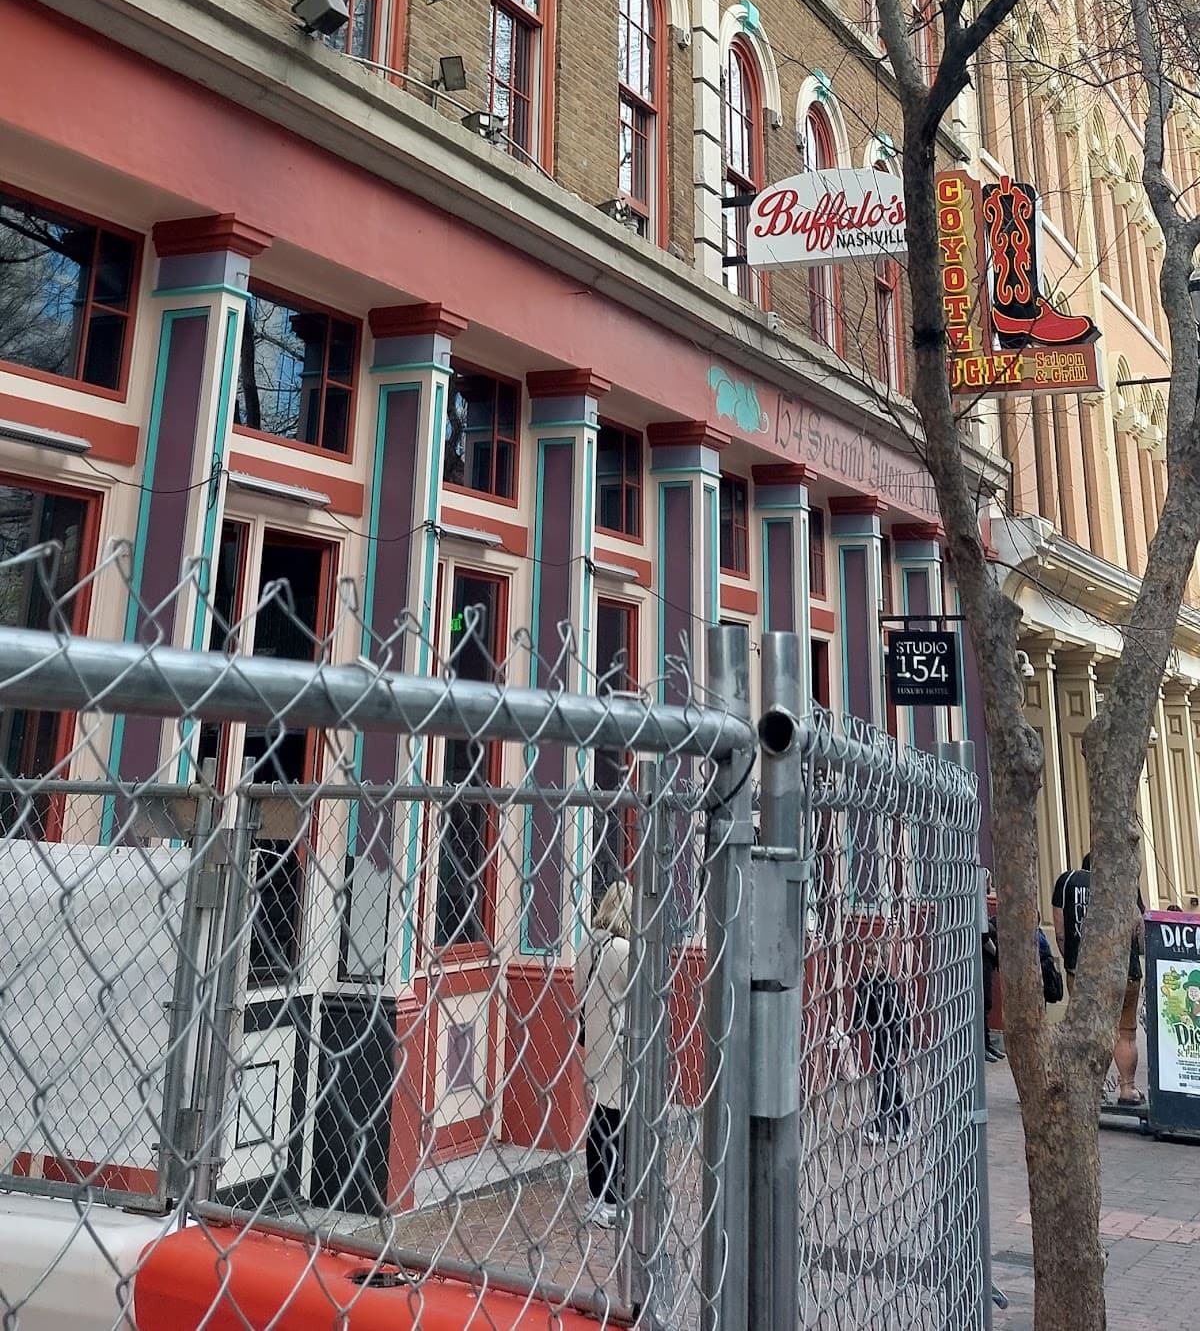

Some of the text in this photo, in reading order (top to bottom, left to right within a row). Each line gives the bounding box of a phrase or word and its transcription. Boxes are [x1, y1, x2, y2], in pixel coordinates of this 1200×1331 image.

[754, 189, 907, 252] Buffalo's
[937, 178, 974, 353] COYOTE
[946, 355, 1023, 387] UGLY
[1034, 351, 1085, 367] Saloon
[1034, 367, 1089, 384] & Grill
[774, 393, 804, 455] 154
[807, 413, 865, 482] Second
[896, 641, 948, 654] STUDIO
[896, 655, 949, 682] 154
